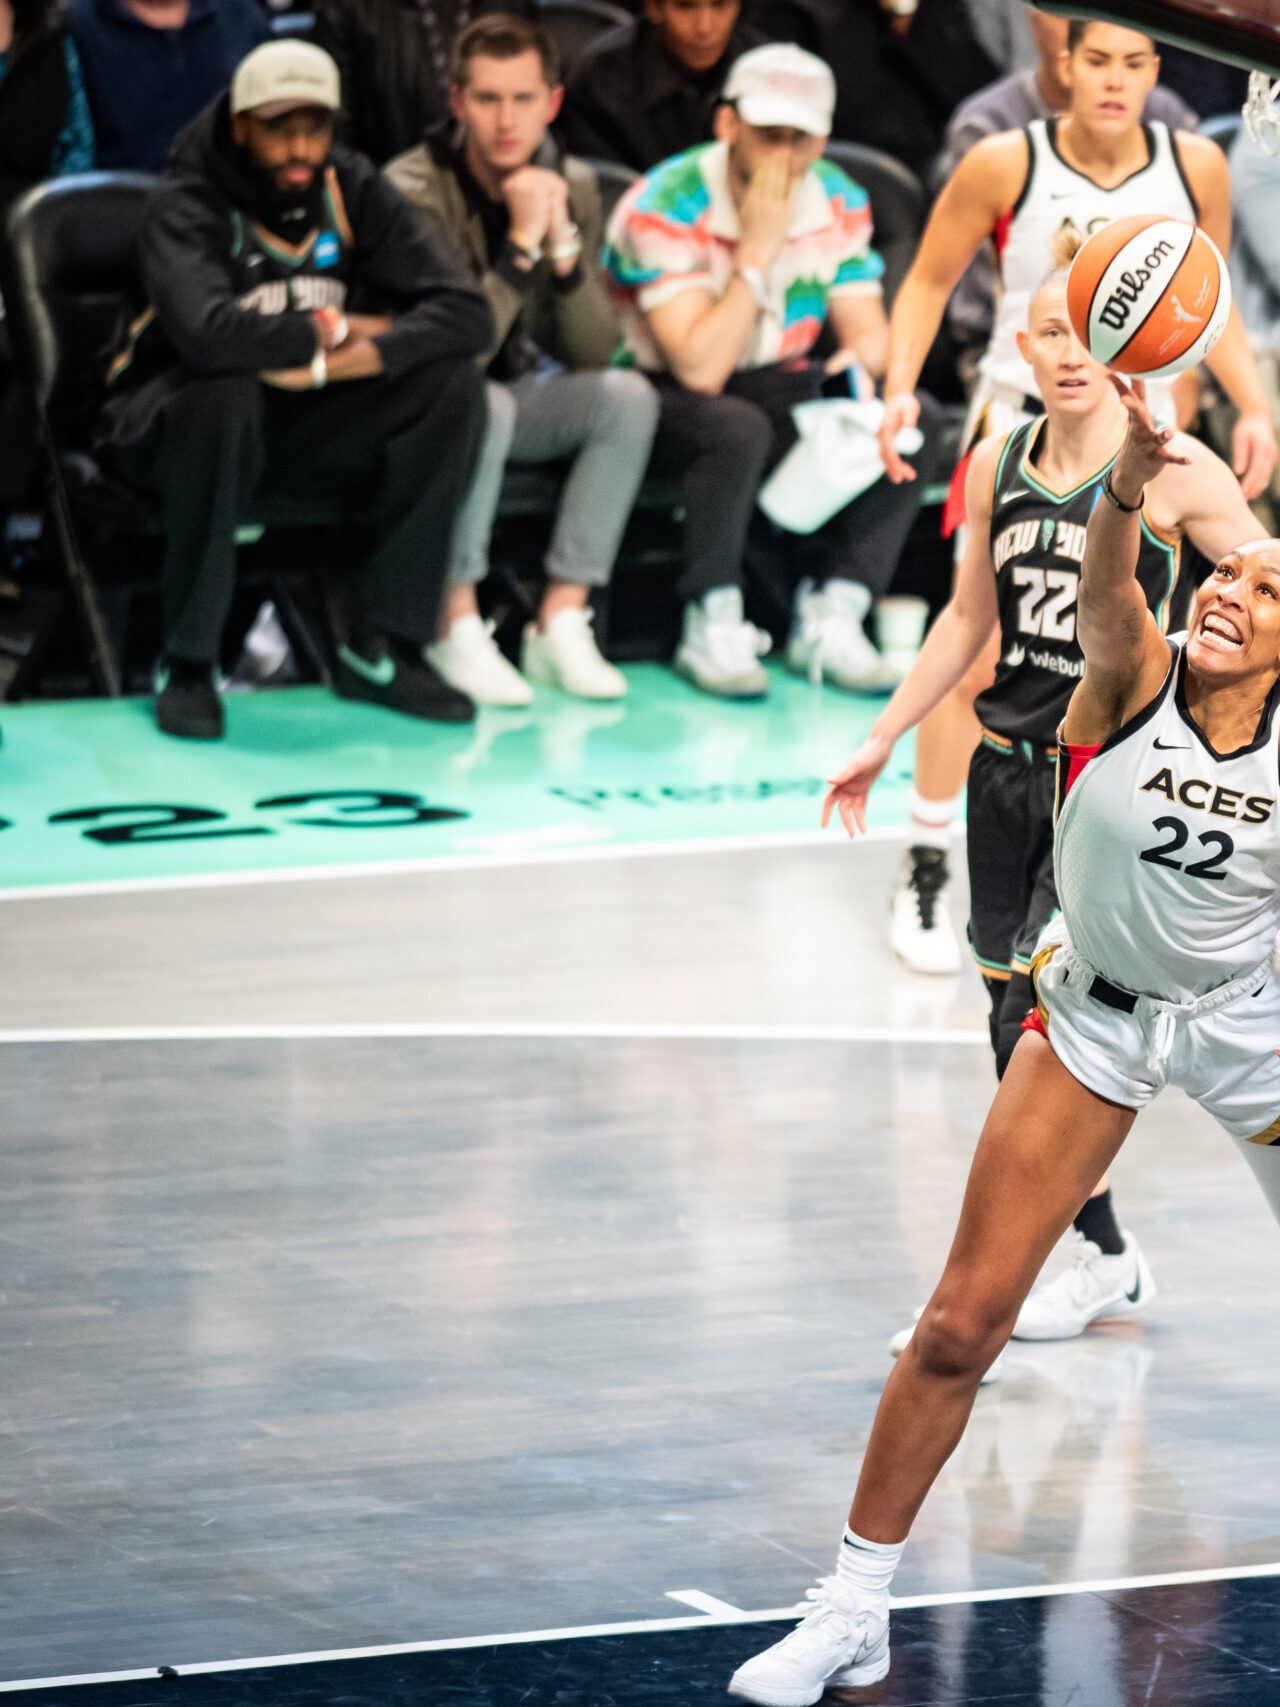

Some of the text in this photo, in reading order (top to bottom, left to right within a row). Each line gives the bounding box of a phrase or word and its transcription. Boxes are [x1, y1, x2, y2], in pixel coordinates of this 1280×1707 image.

[1098, 240, 1176, 331] Wilson
[1055, 520, 1087, 562] YO
[1013, 566, 1079, 641] 22
[1030, 651, 1085, 677] Webul
[0, 790, 470, 846] 23
[1139, 767, 1276, 825] ACES
[1140, 816, 1234, 880] 22
